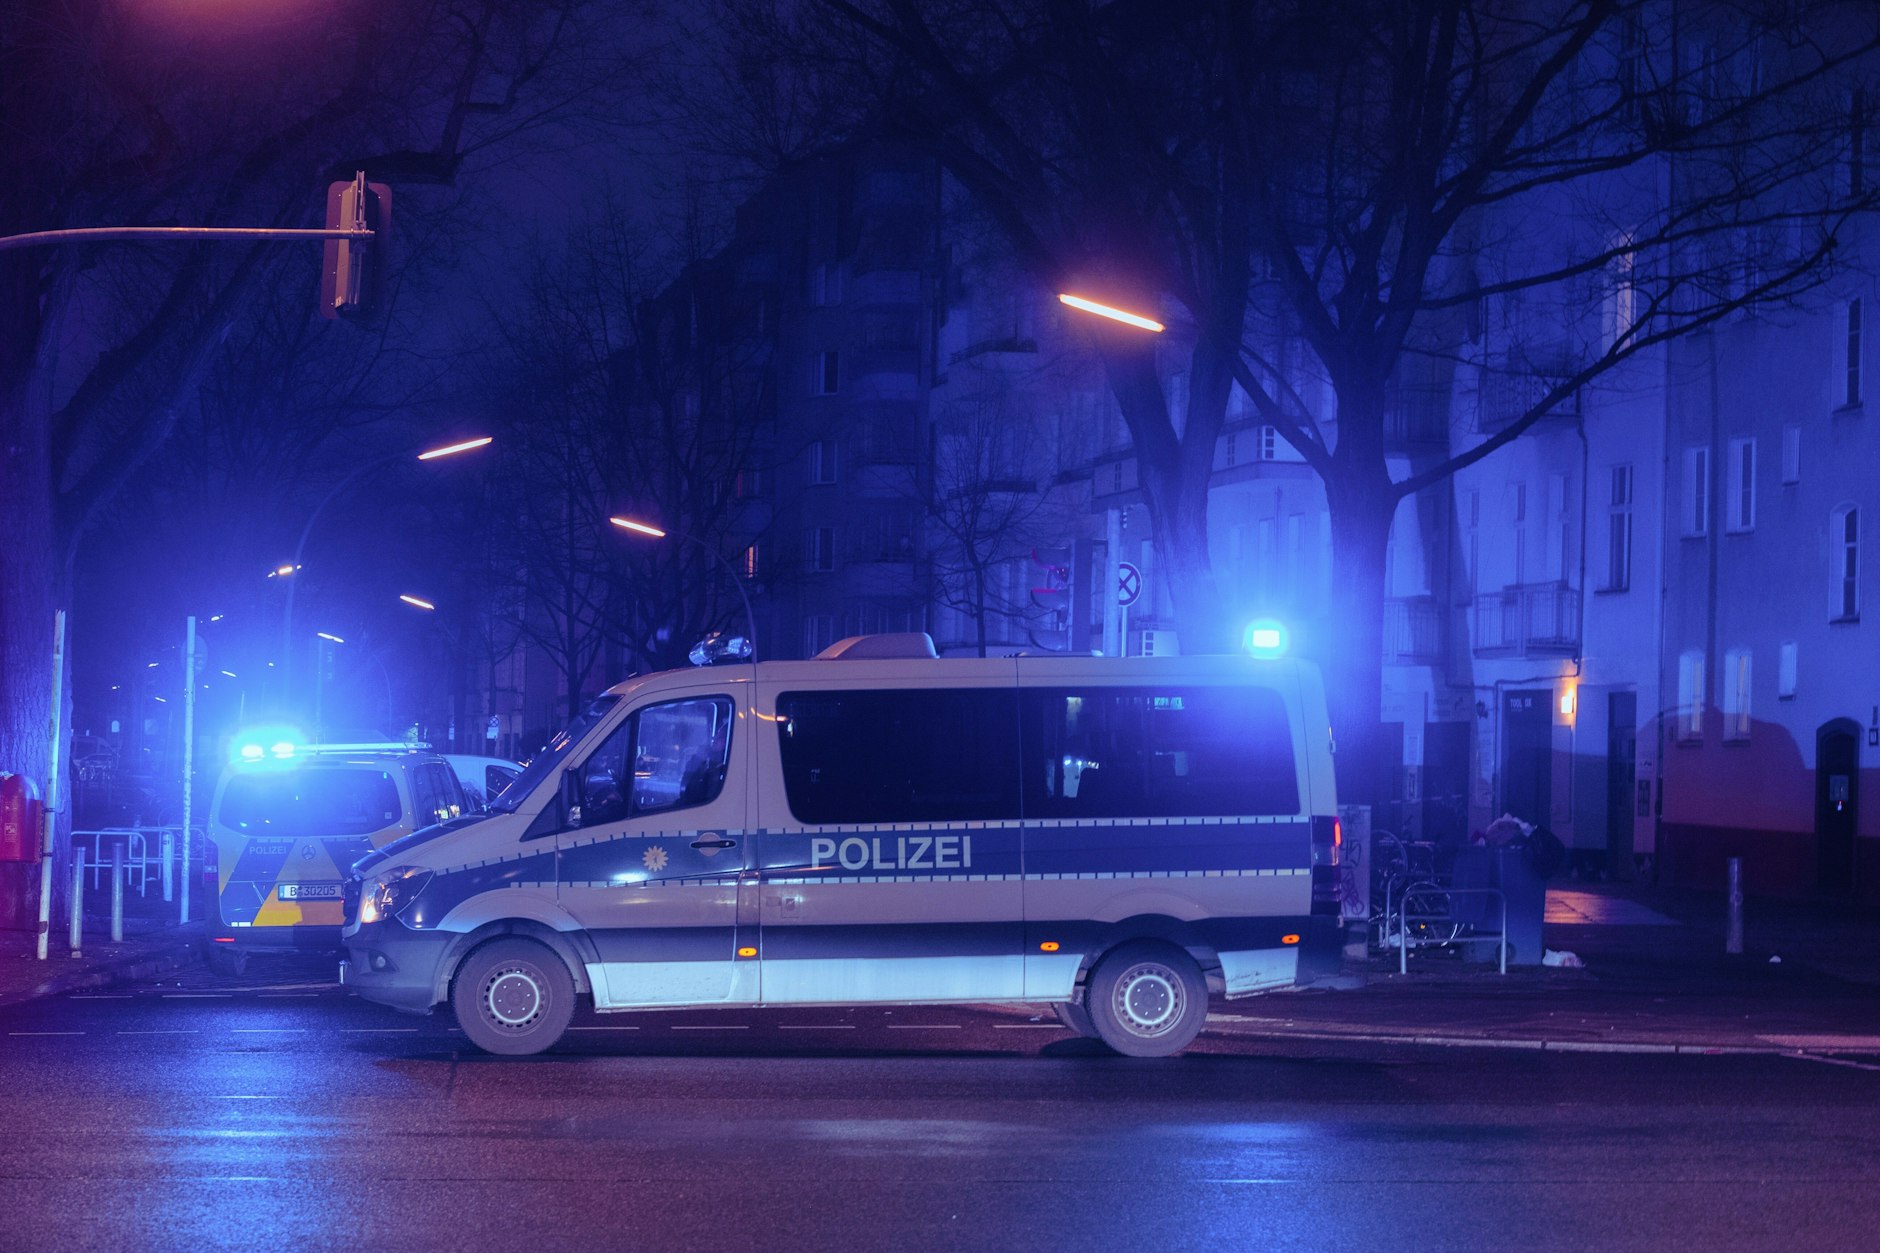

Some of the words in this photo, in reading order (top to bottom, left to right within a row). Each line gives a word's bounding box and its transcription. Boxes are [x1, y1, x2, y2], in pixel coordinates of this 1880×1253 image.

[249, 846, 287, 855] POLIZEI
[811, 835, 972, 871] POLIZEI
[304, 885, 336, 896] 30205
